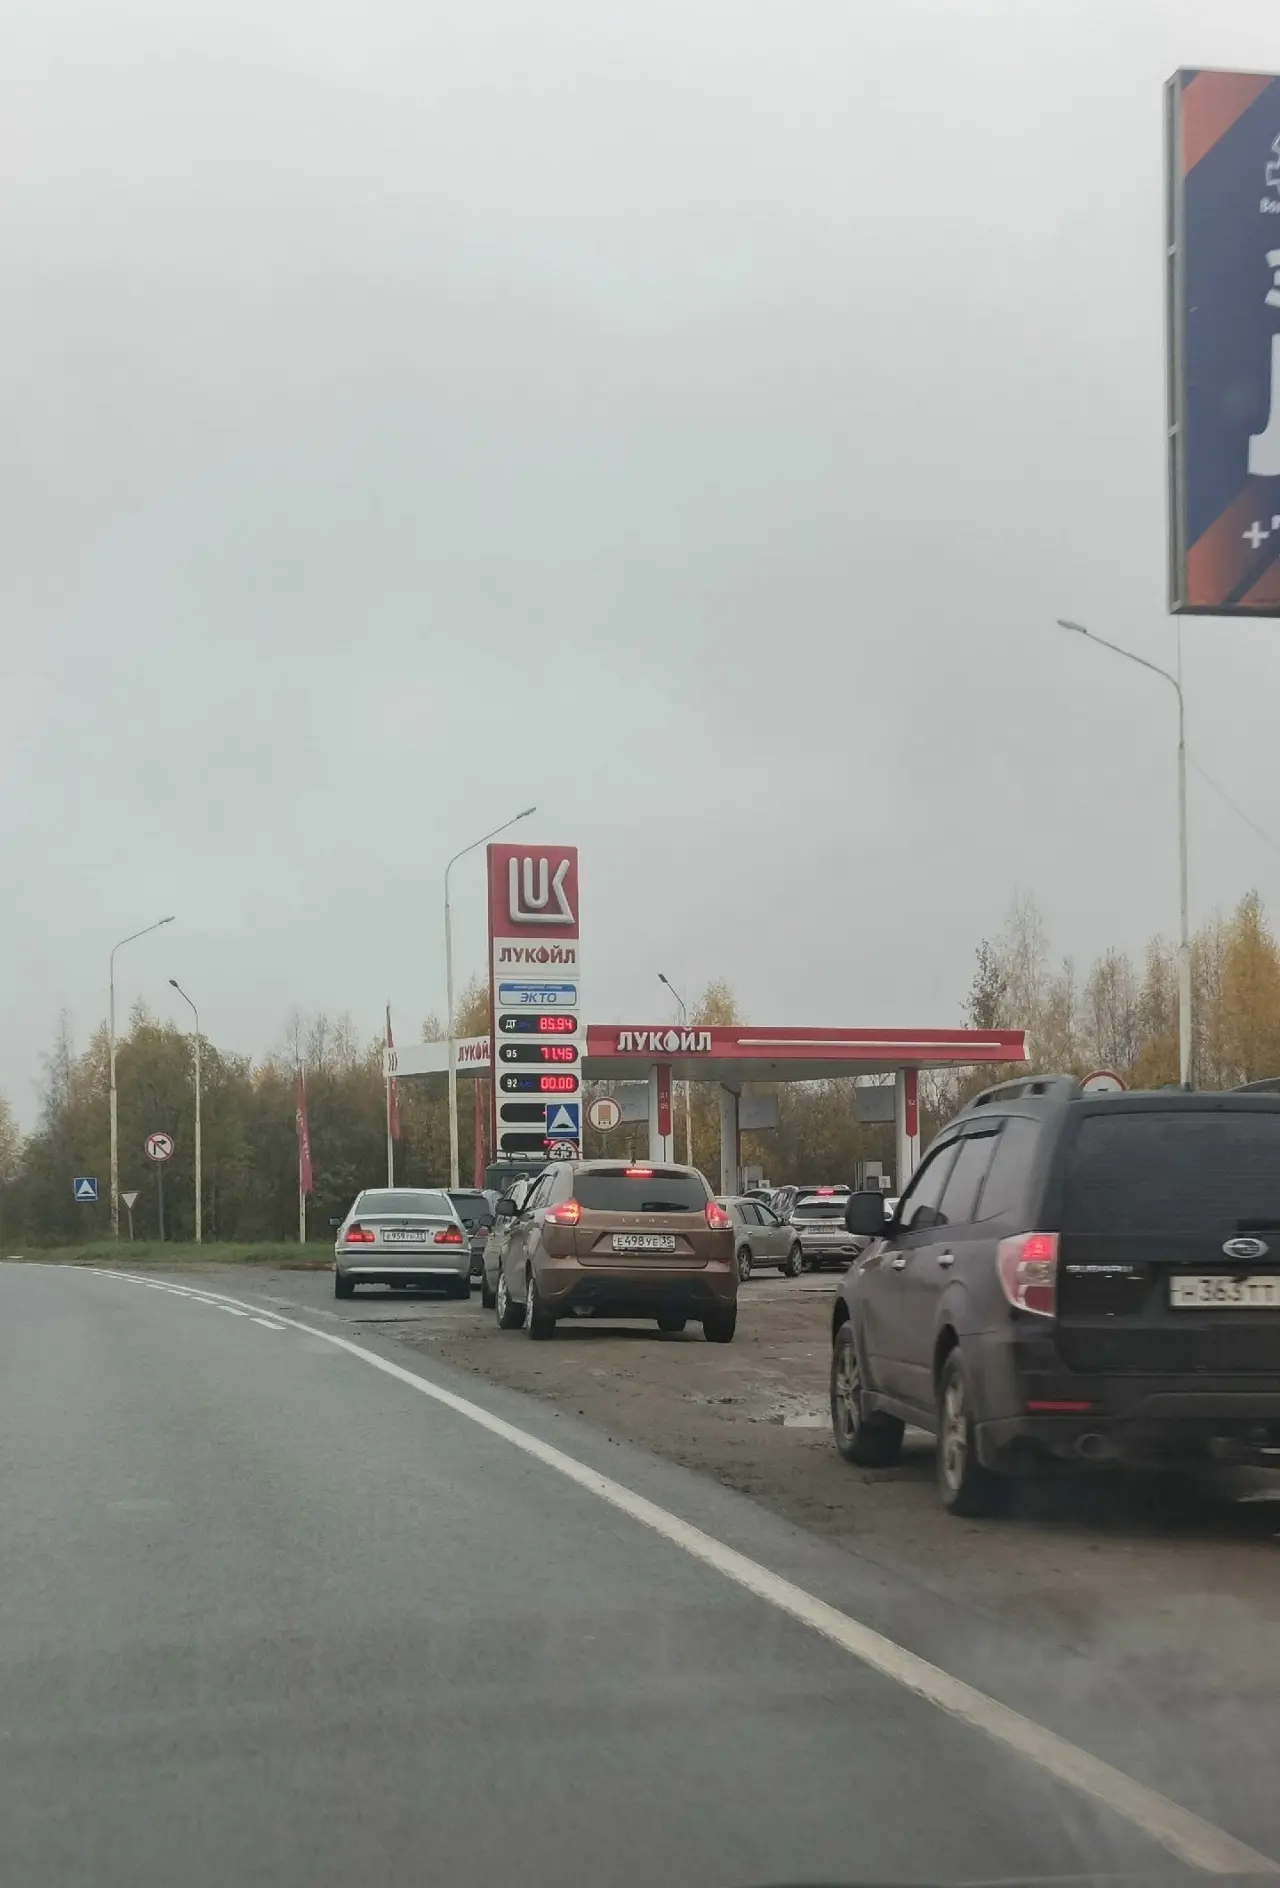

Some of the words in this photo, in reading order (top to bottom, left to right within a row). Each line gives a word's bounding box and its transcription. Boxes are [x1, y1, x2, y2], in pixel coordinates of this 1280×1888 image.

[499, 944, 576, 964] ЛУКОЙЛ
[520, 992, 557, 1003] ЭКТО
[505, 1019, 517, 1029] ДТ
[540, 1018, 573, 1030] 85.94
[617, 1026, 712, 1052] ЛУКОЙЛ
[458, 1040, 491, 1062] ЛУКОЙ
[506, 1049, 517, 1058] 95
[541, 1047, 573, 1060] 71.45
[507, 1078, 517, 1088] 92
[540, 1077, 574, 1090] 00.00
